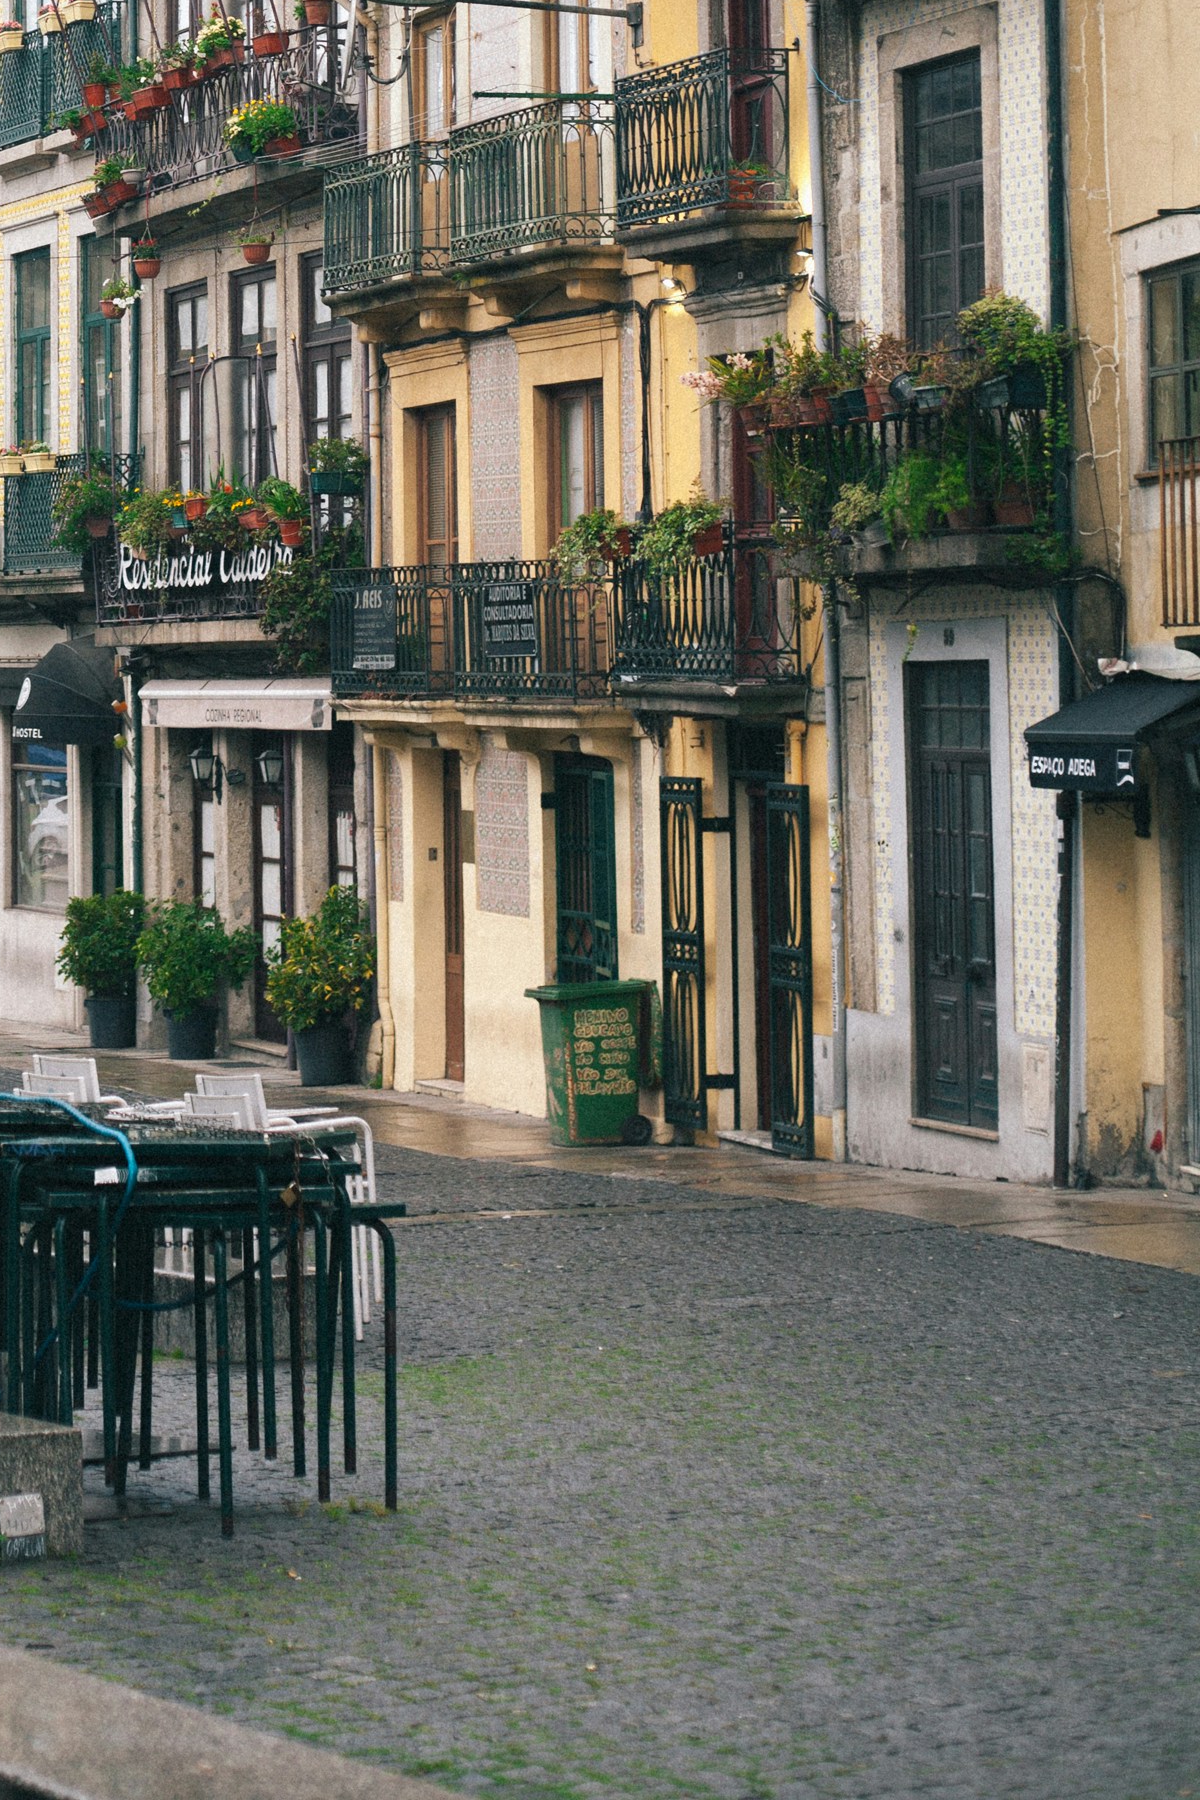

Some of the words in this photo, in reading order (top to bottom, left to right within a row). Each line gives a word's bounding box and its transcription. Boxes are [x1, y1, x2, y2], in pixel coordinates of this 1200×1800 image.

[488, 585, 521, 601] AUDITORIA
[522, 585, 527, 600] E
[483, 604, 534, 621] CONSULTADORIA
[205, 708, 231, 723] COZINHA
[233, 708, 262, 723] REGIONAL
[1031, 756, 1065, 778] ESPAÇO
[1068, 758, 1097, 777] ADEGA
